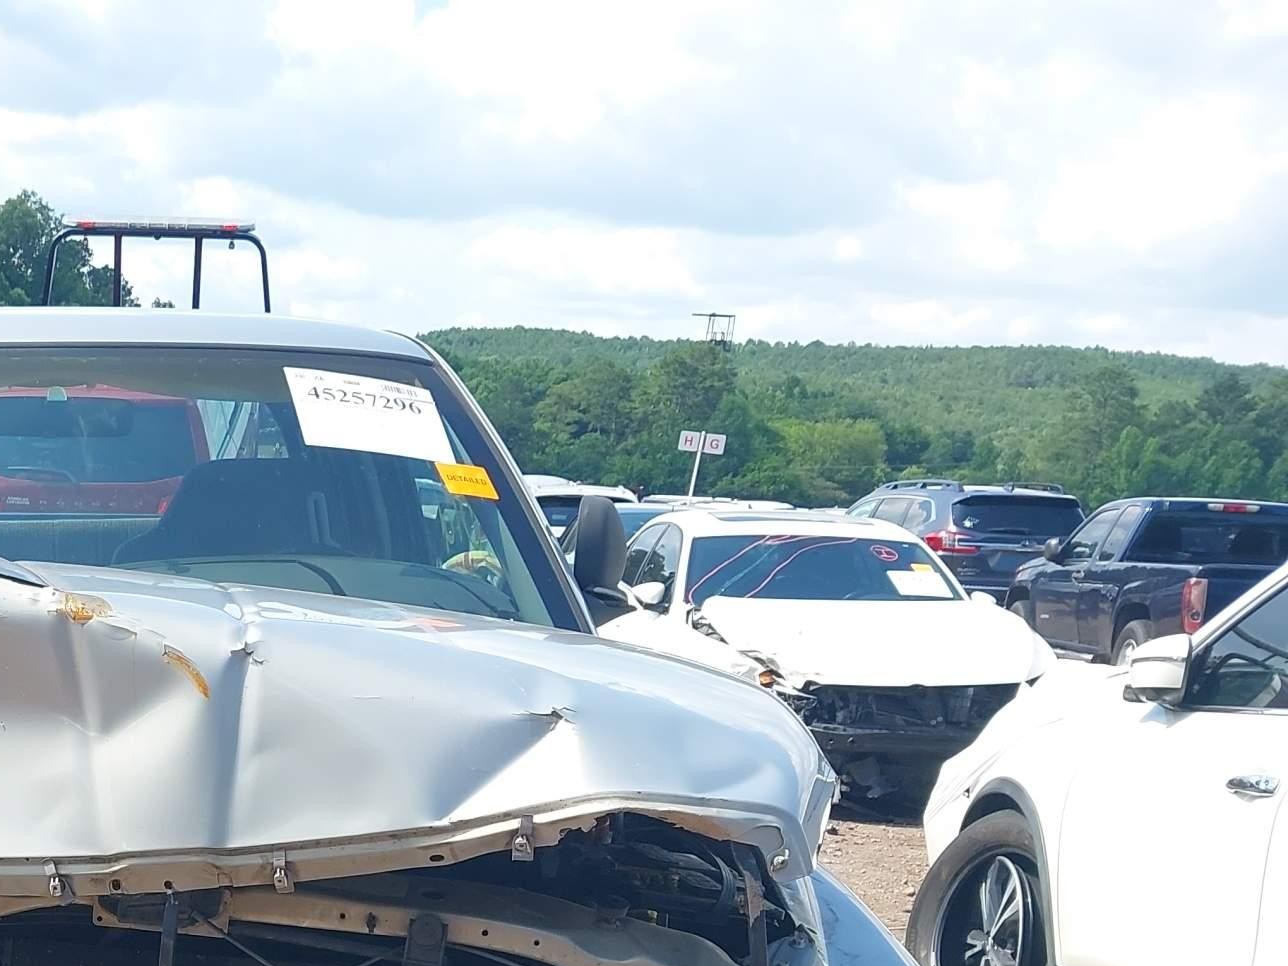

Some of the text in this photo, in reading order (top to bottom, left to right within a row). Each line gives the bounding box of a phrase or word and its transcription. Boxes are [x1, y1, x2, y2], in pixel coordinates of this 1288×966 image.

[307, 386, 422, 415] 45257296
[684, 436, 693, 446] H
[710, 439, 720, 449] G
